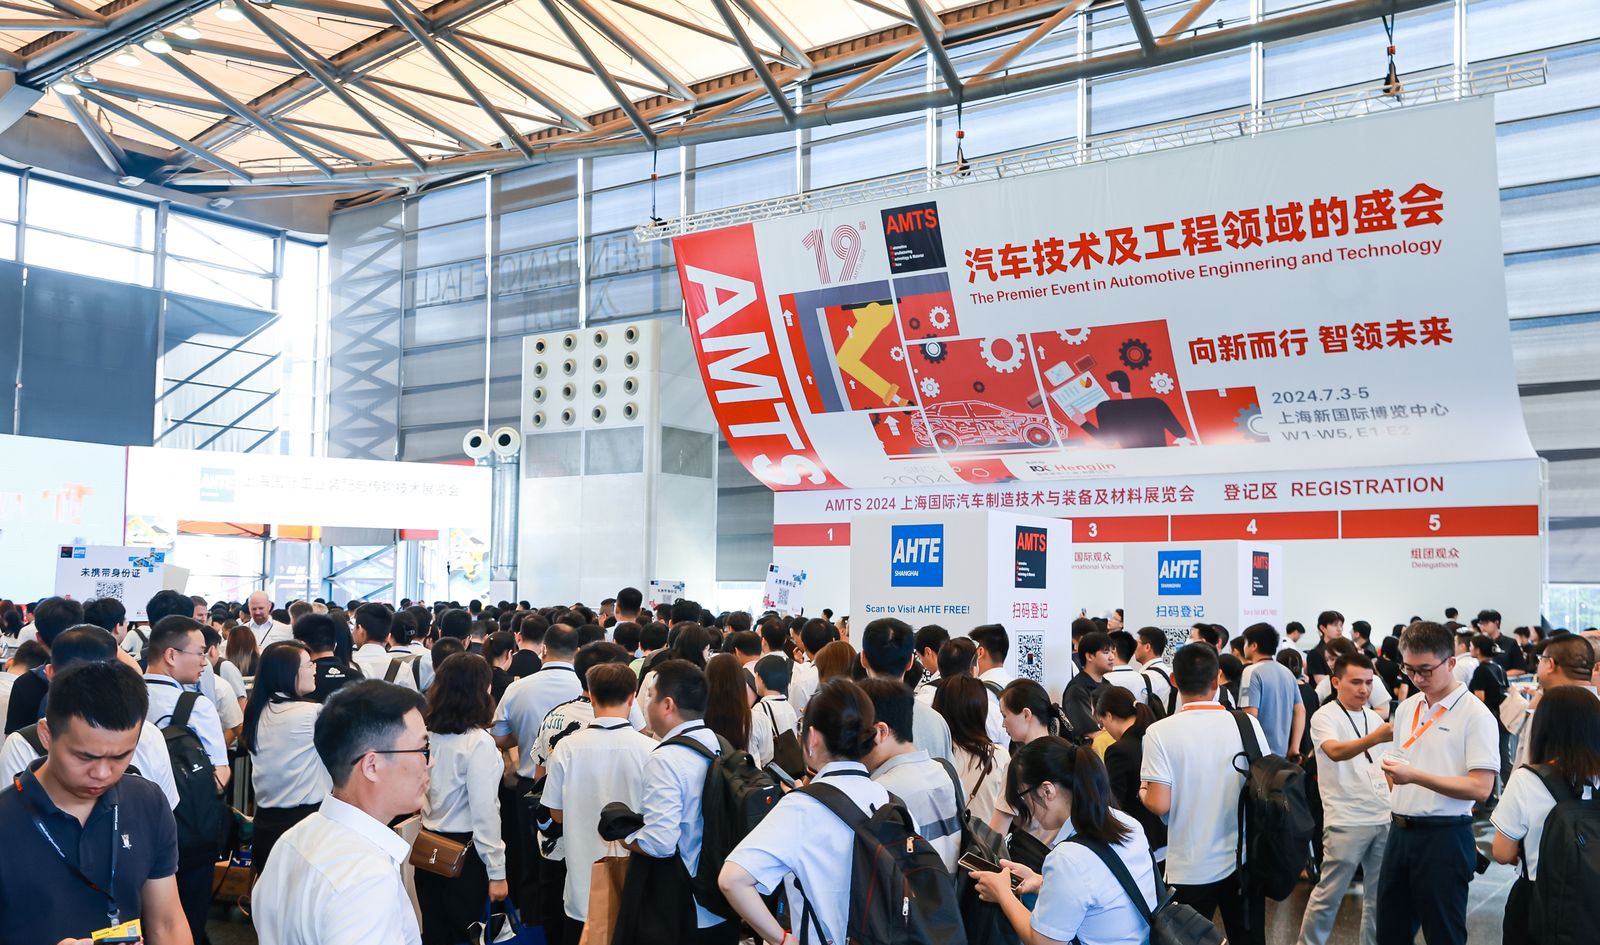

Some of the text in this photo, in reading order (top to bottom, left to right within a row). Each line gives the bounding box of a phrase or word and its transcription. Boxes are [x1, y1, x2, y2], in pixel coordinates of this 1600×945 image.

[886, 208, 938, 235] AMTS
[965, 183, 1443, 284] 汽车技术及工程领域的盛会
[801, 224, 862, 285] 19
[970, 239, 1443, 305] The Premier Event in Automotive Enginnering and Technology
[1188, 316, 1454, 365] 向新而行 智领未来
[685, 264, 827, 486] AMTS
[1271, 386, 1370, 404] 2024.7.3-5
[1278, 402, 1449, 425] 上海新国际博览中心
[1281, 428, 1352, 441] W1-W5,
[1224, 482, 1278, 501] 登记区
[1291, 476, 1444, 497] REGISTRATION
[825, 484, 1195, 512] AMTS 2024 上海国际汽车制造技术与装备及材料展览会
[1088, 522, 1098, 537] 3
[1246, 518, 1258, 534] 4
[1428, 514, 1441, 531] 5
[827, 528, 834, 541] 1
[1016, 532, 1046, 552] AMTS
[892, 537, 941, 563] AHTE
[1074, 552, 1112, 561] 国际观众
[1411, 547, 1460, 559] 组团观众
[81, 567, 140, 577] 未携带身份证
[1159, 559, 1199, 579] AHTE
[1411, 561, 1458, 569] Delegations
[865, 604, 970, 614] Scan to Visit AHTE FREE!
[1012, 601, 1048, 618] 扫码登记
[1156, 605, 1204, 617] 扫码登记
